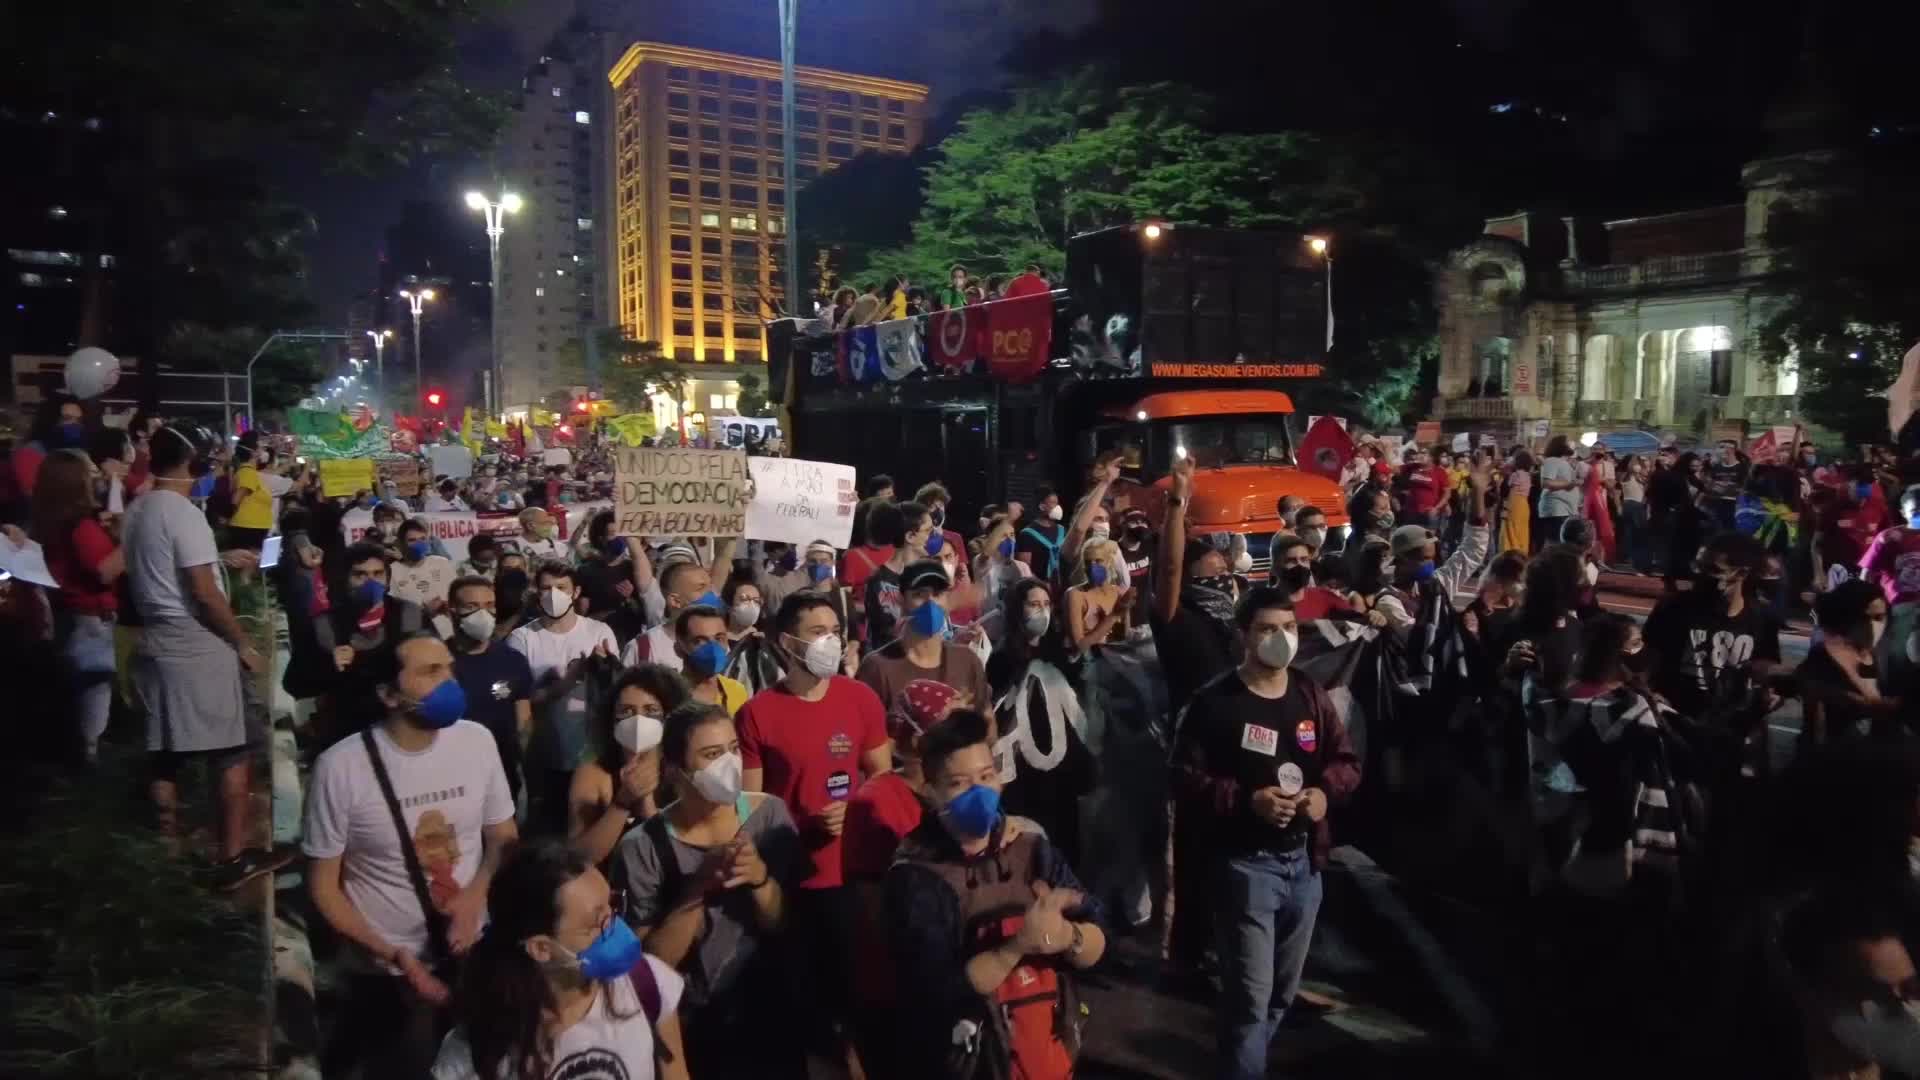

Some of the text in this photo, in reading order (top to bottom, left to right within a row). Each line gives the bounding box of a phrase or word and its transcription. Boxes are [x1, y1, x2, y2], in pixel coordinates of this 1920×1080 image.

[1152, 363, 1321, 377] WWW.MEGASOMEVENTOS.COM.BR
[617, 452, 744, 480] UNIDOS PELA
